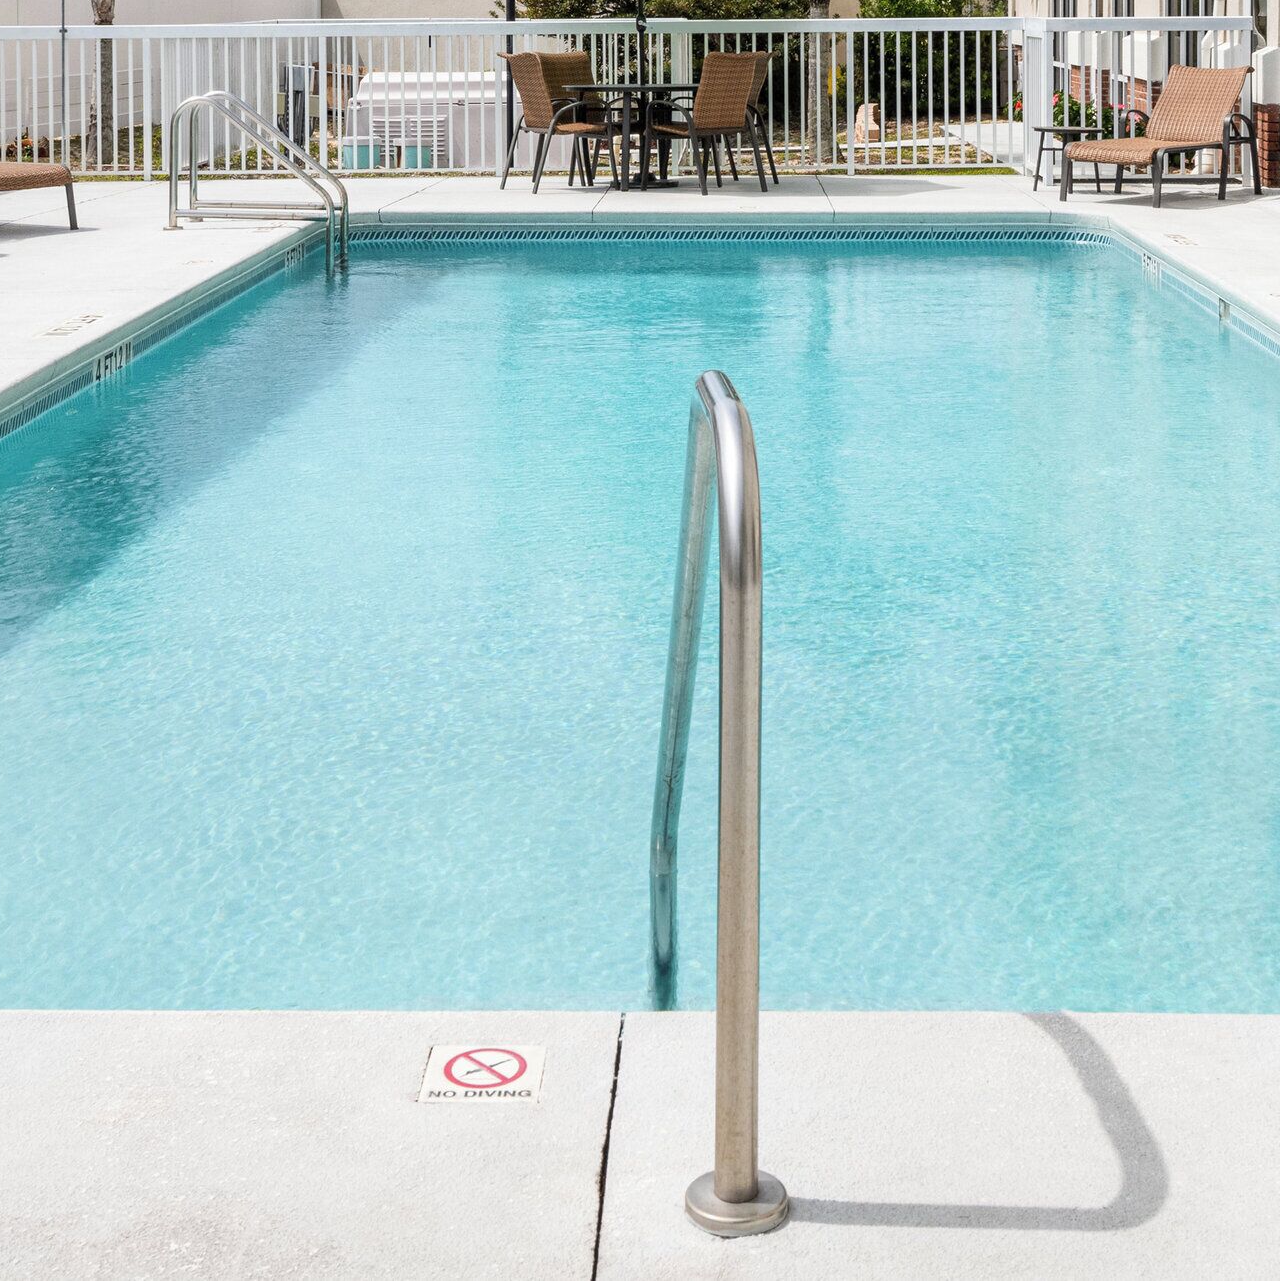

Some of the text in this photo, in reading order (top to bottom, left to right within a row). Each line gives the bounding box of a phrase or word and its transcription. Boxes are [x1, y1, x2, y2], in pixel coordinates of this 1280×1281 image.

[95, 358, 102, 381] 4
[428, 1089, 532, 1098] NO DIVING
